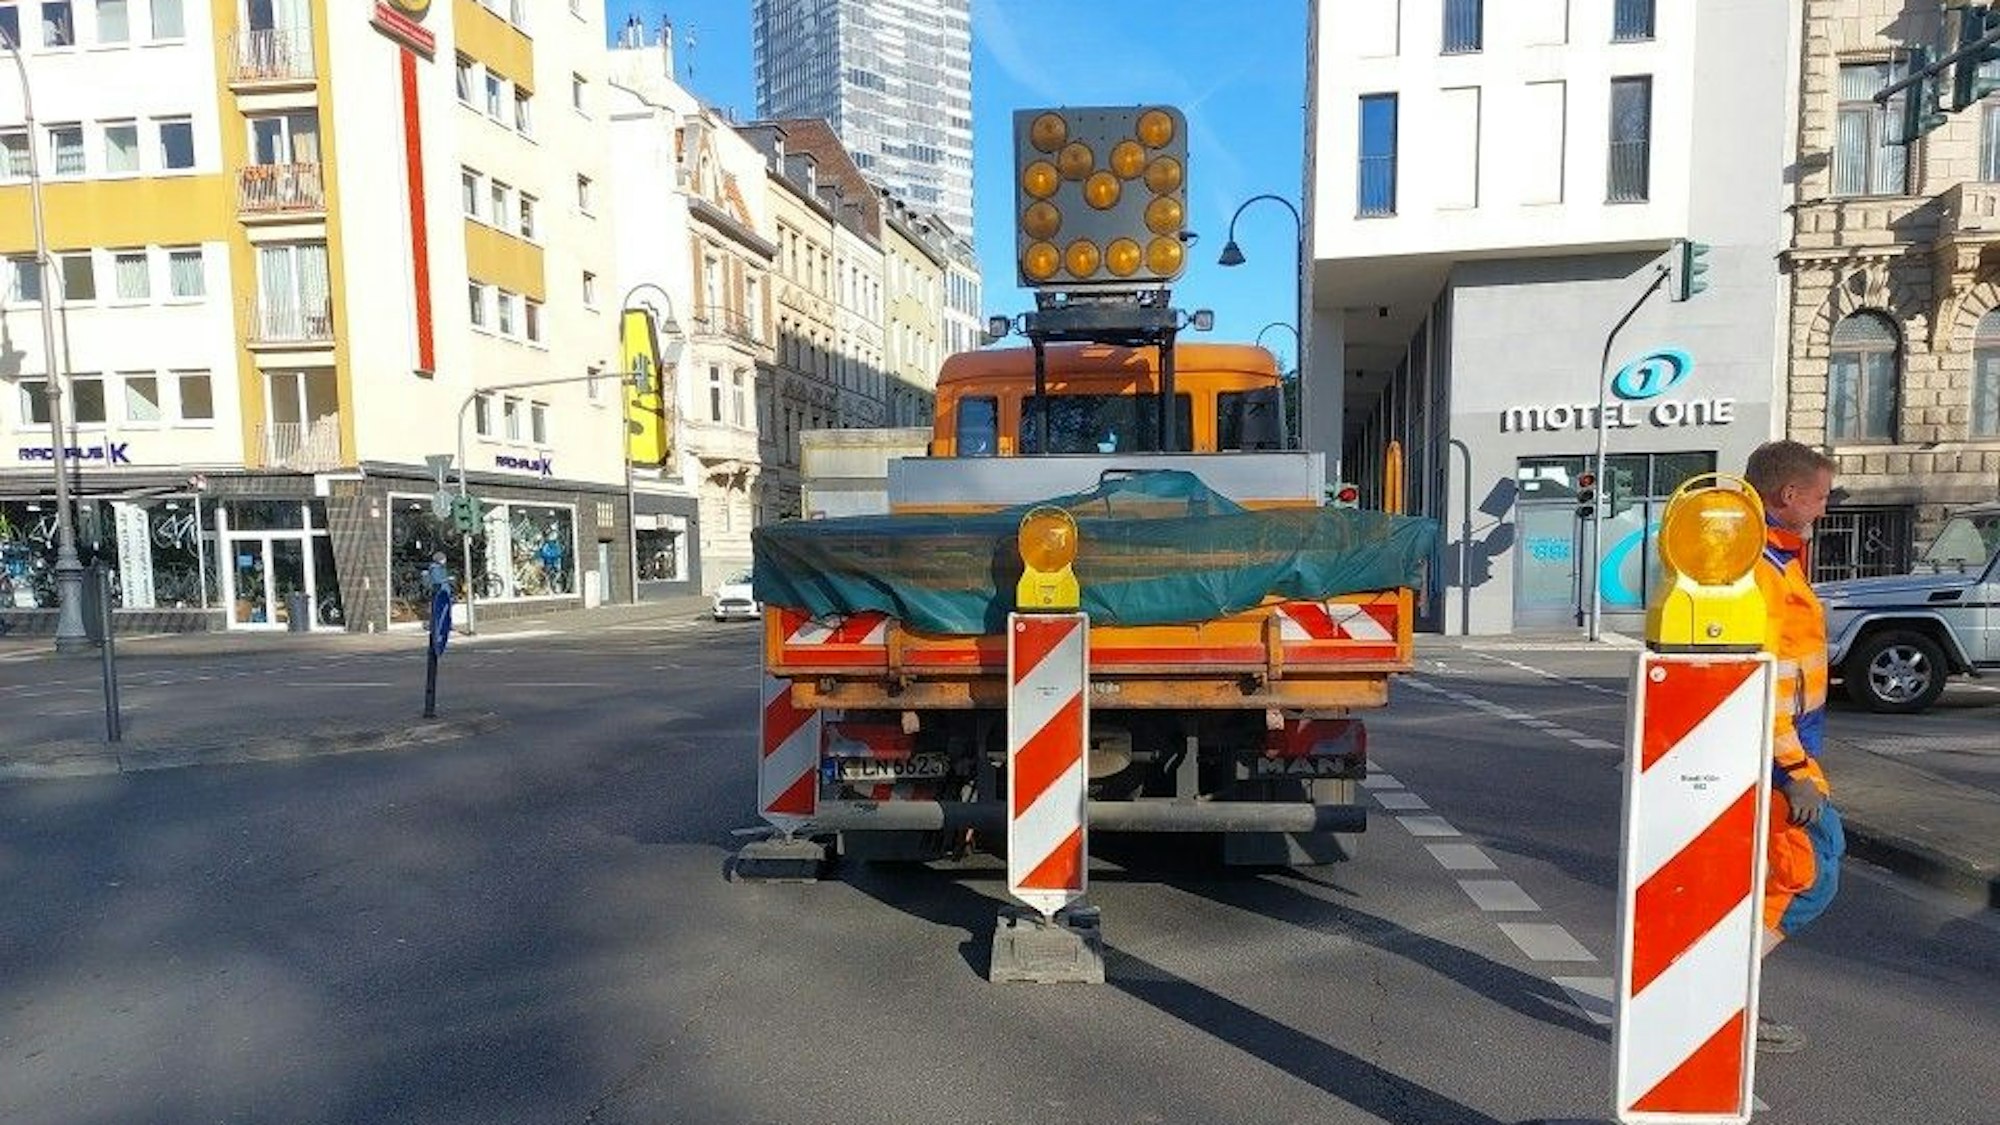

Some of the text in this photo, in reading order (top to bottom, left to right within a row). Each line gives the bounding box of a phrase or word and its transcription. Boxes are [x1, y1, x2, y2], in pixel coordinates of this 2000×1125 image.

[1649, 397, 1735, 428] ONE
[19, 447, 104, 460] RADAUS
[1258, 757, 1344, 774] MAN
